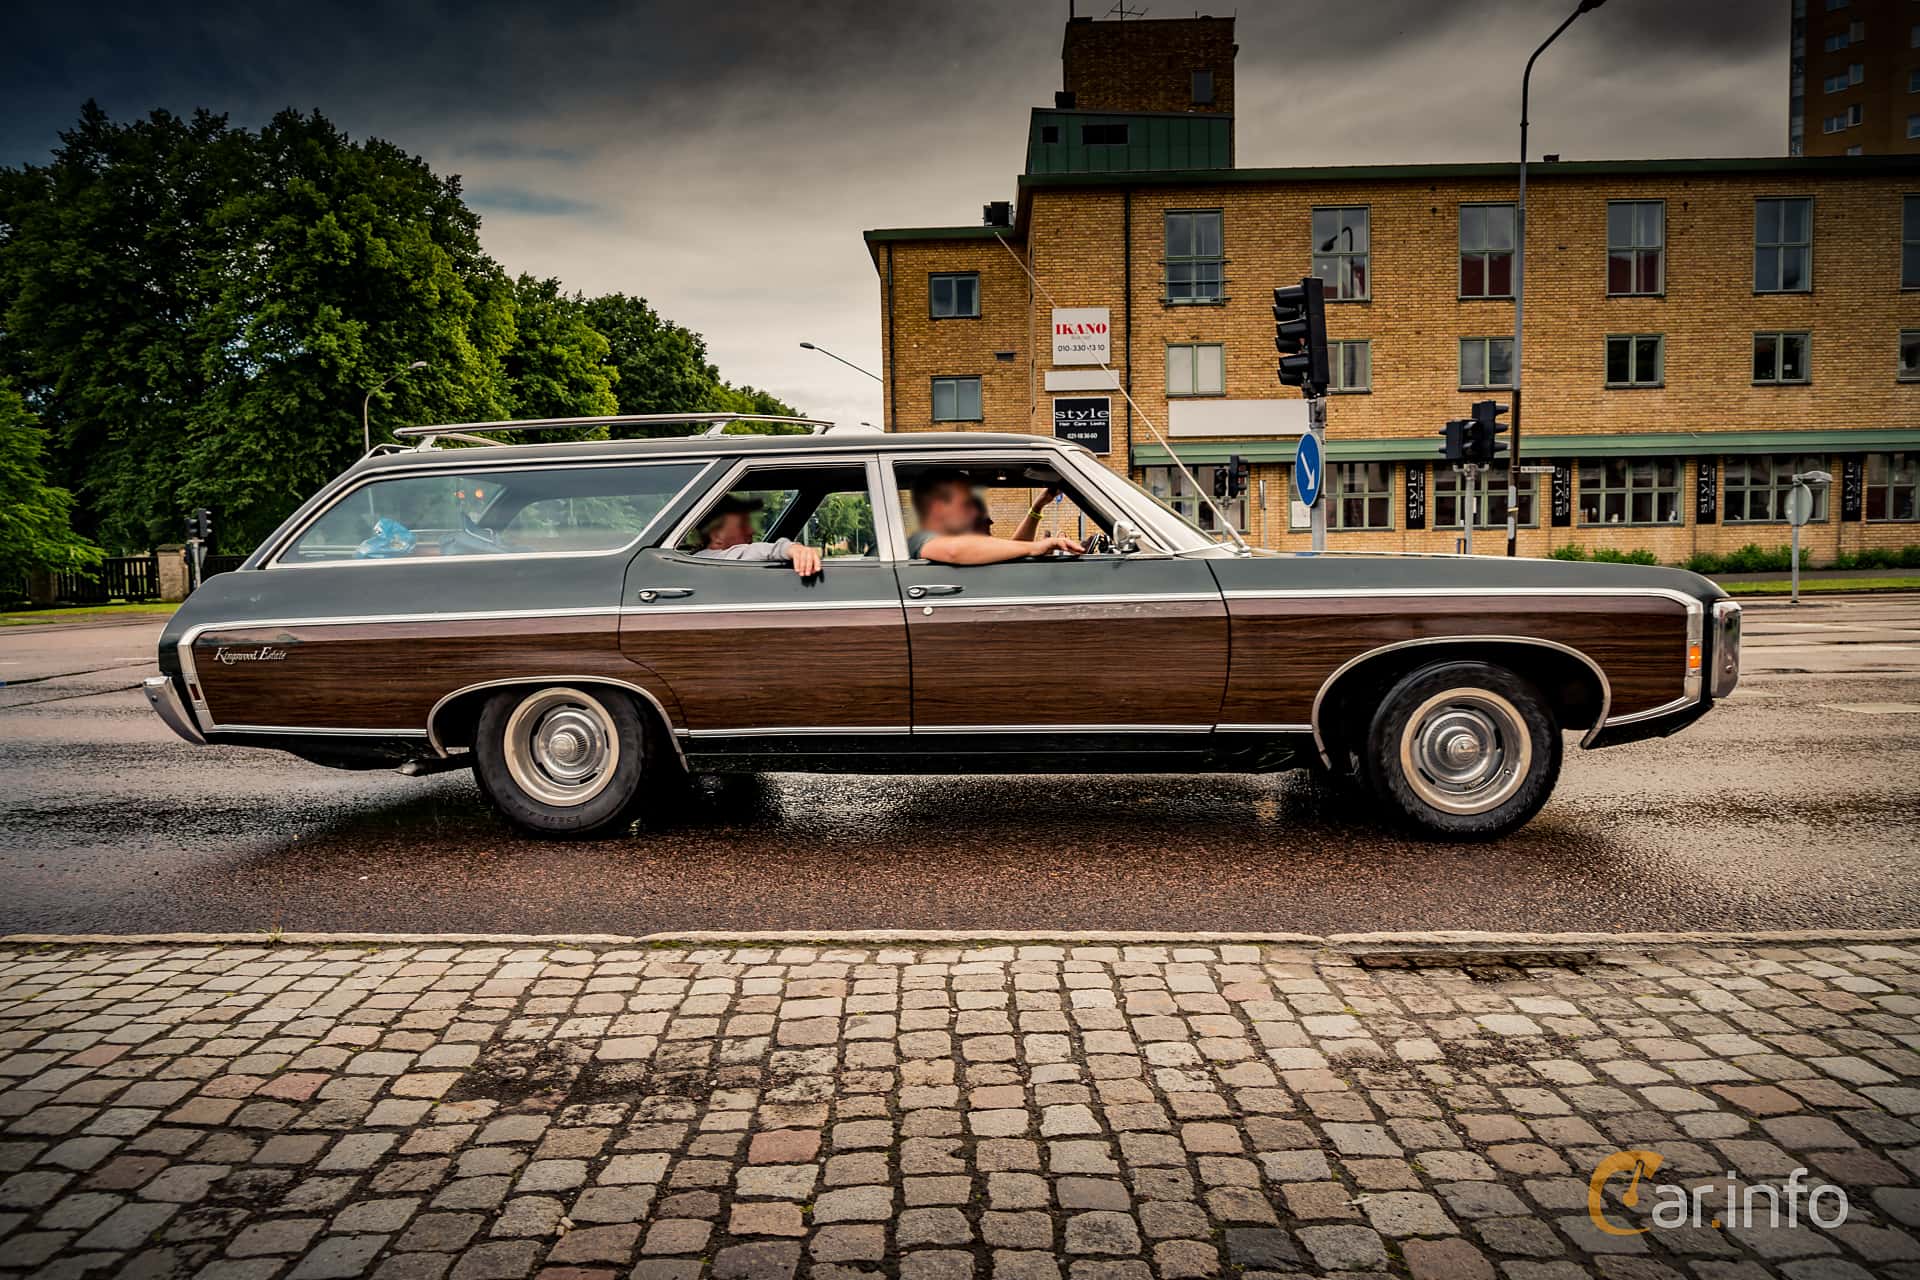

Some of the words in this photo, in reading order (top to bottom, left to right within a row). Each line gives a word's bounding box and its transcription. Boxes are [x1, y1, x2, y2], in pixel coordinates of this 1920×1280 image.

[1056, 323, 1107, 335] IKANO
[1055, 408, 1109, 420] style
[1407, 469, 1418, 519] style
[1553, 466, 1564, 517] style
[1699, 463, 1710, 514] style
[1844, 461, 1856, 511] style
